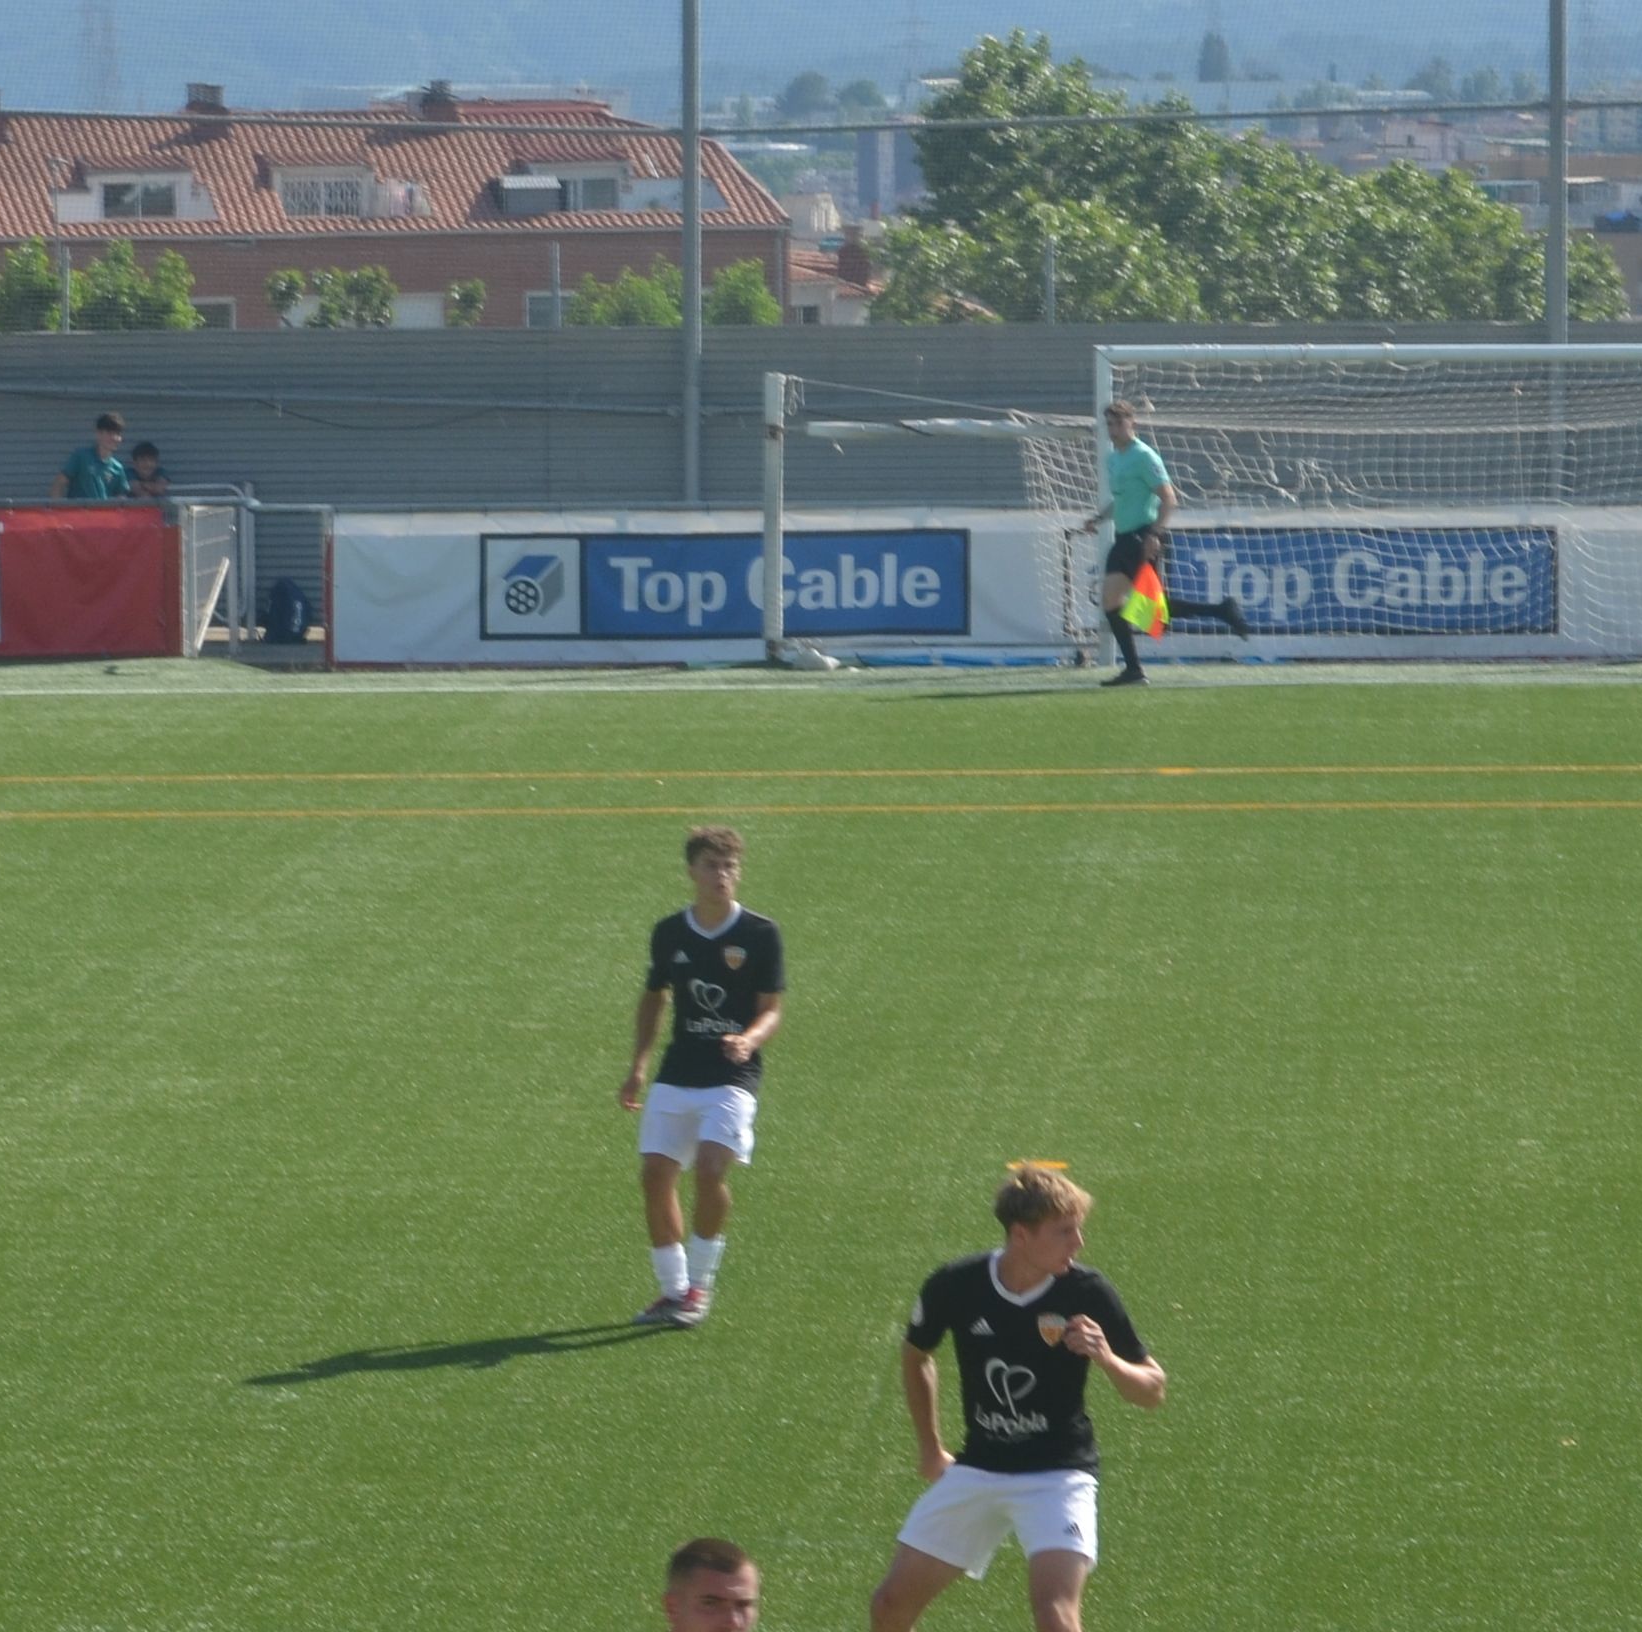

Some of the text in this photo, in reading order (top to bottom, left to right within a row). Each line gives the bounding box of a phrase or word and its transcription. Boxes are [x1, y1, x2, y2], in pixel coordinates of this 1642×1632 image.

[608, 553, 942, 627] Top Cable
[1195, 549, 1528, 621] Top Cable
